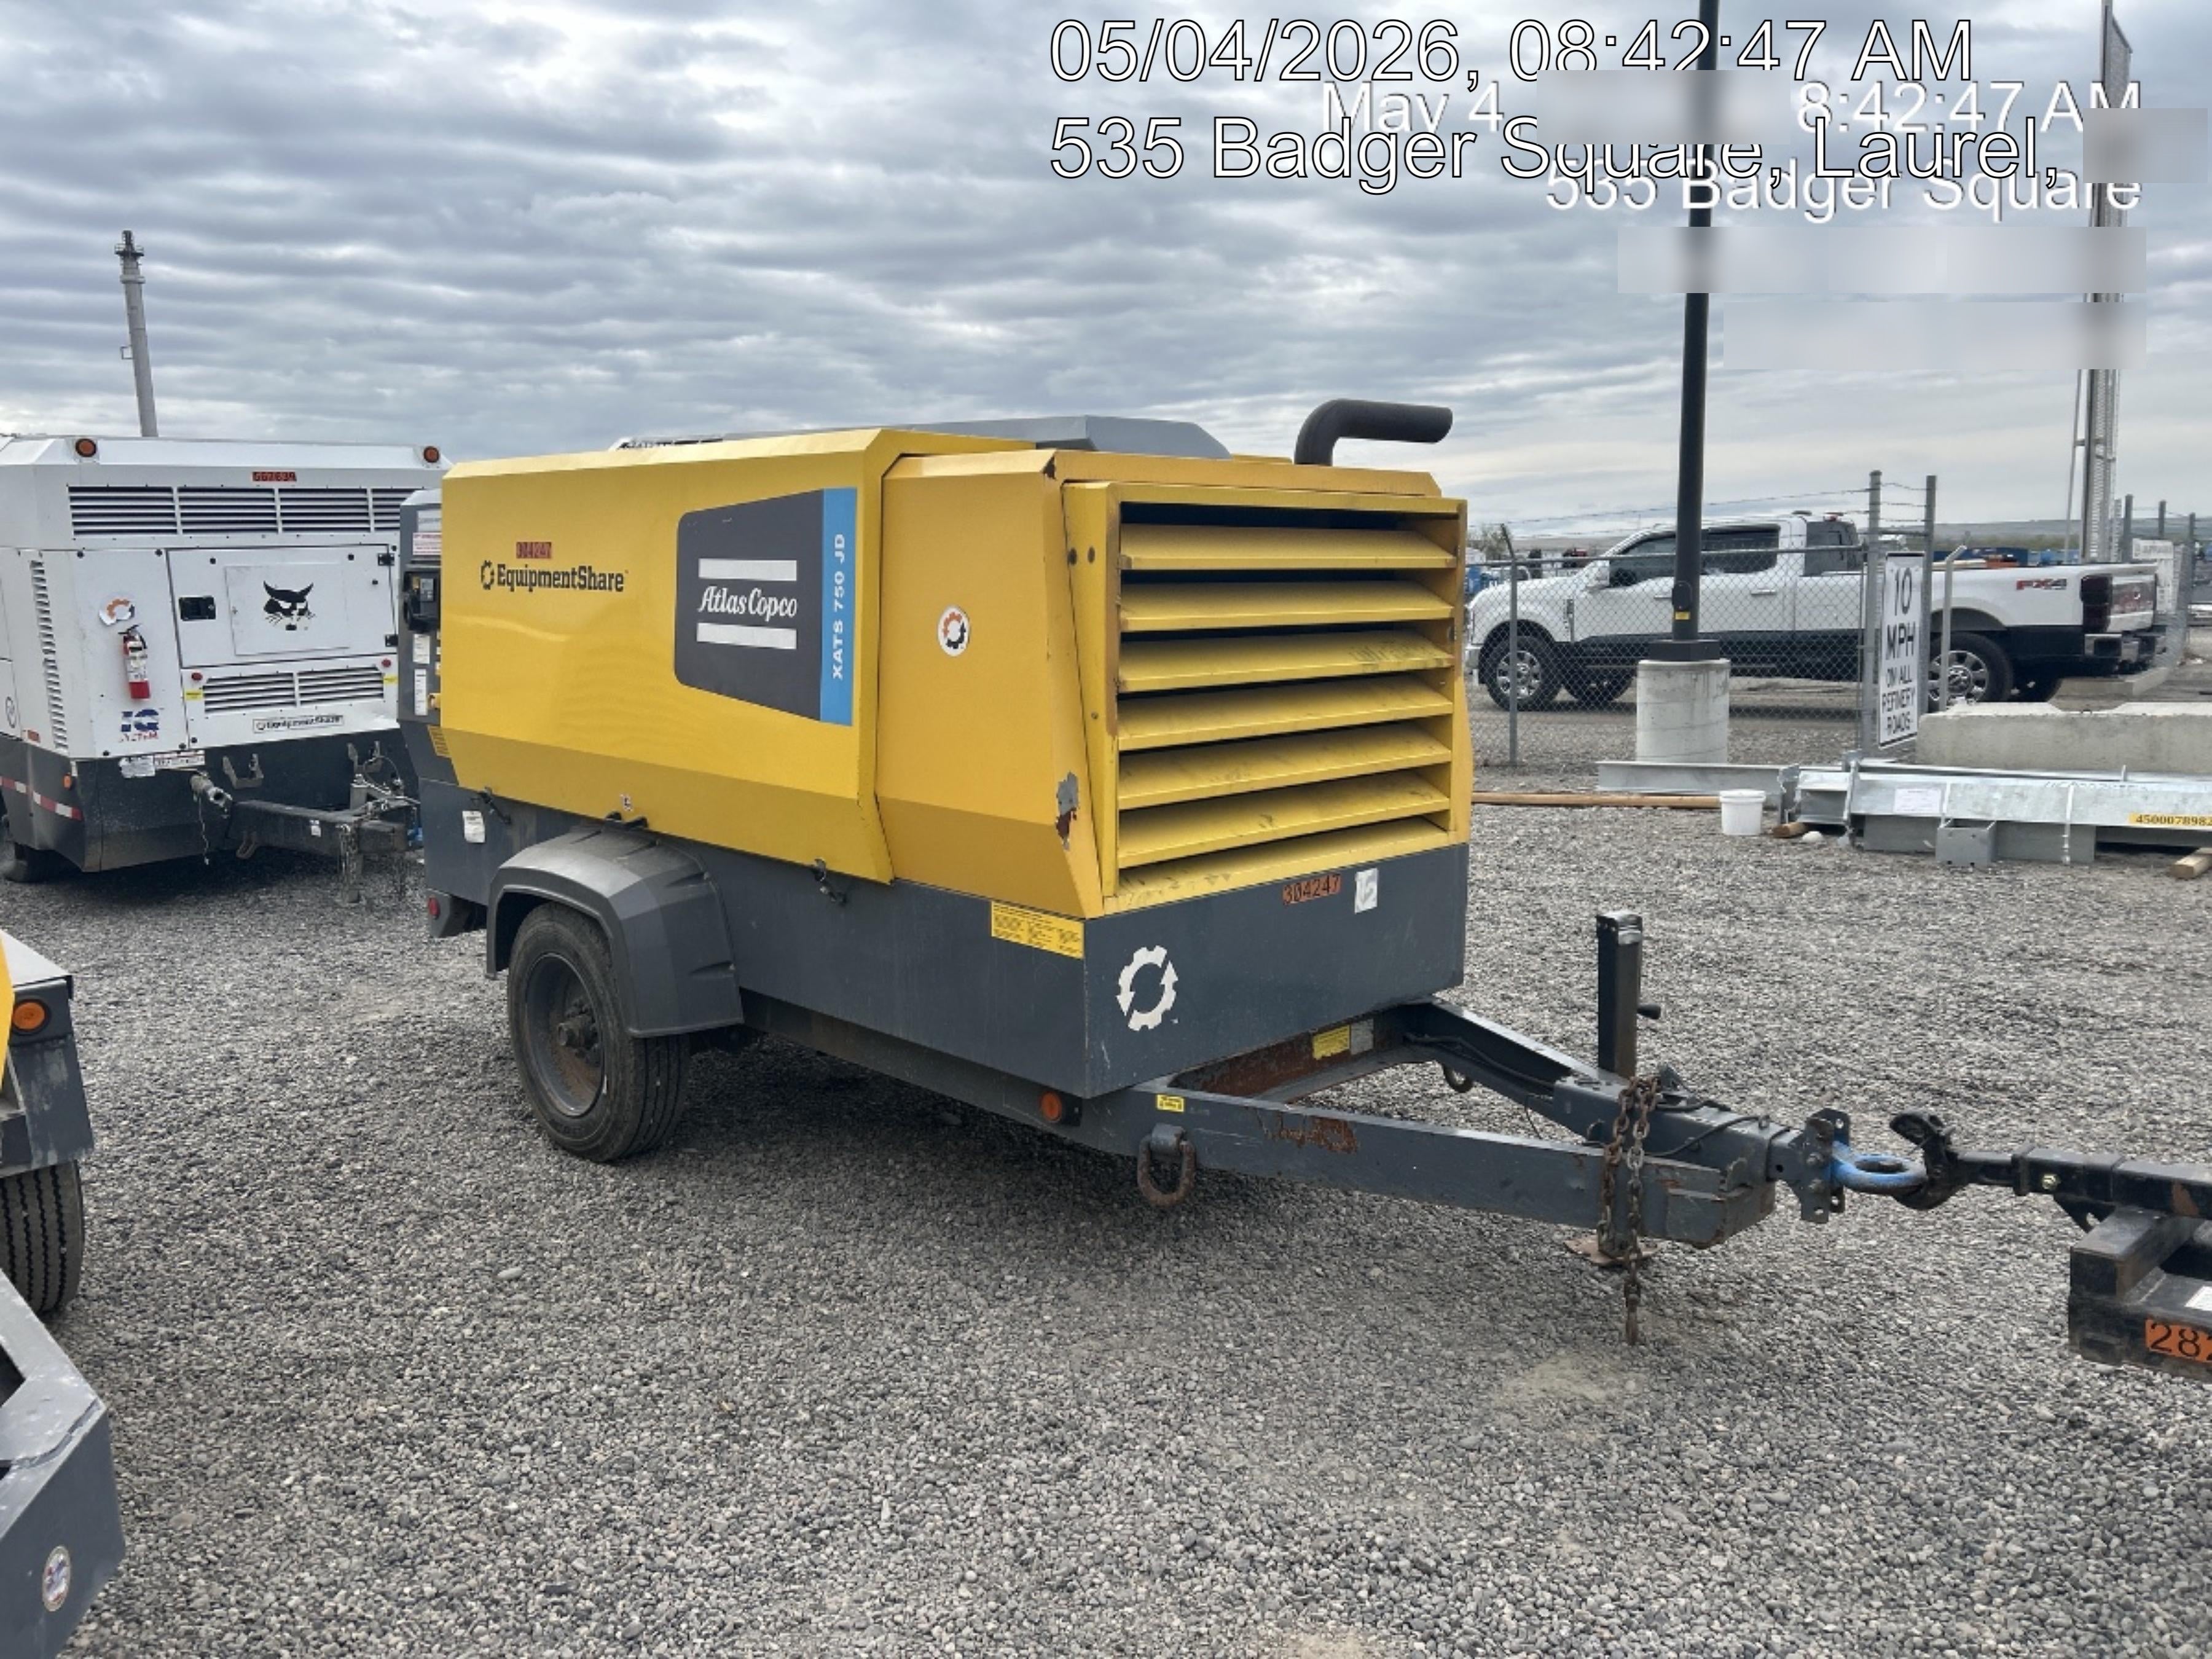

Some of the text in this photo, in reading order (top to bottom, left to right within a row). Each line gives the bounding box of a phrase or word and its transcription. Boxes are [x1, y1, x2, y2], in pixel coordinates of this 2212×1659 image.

[497, 563, 624, 592] EquipmentShare
[1894, 567, 1912, 616] 10
[697, 586, 798, 622] Atlas Copco
[833, 534, 845, 680] XATS 750 JD
[1885, 621, 1915, 660] MPH
[2150, 1322, 2212, 1360] 28
